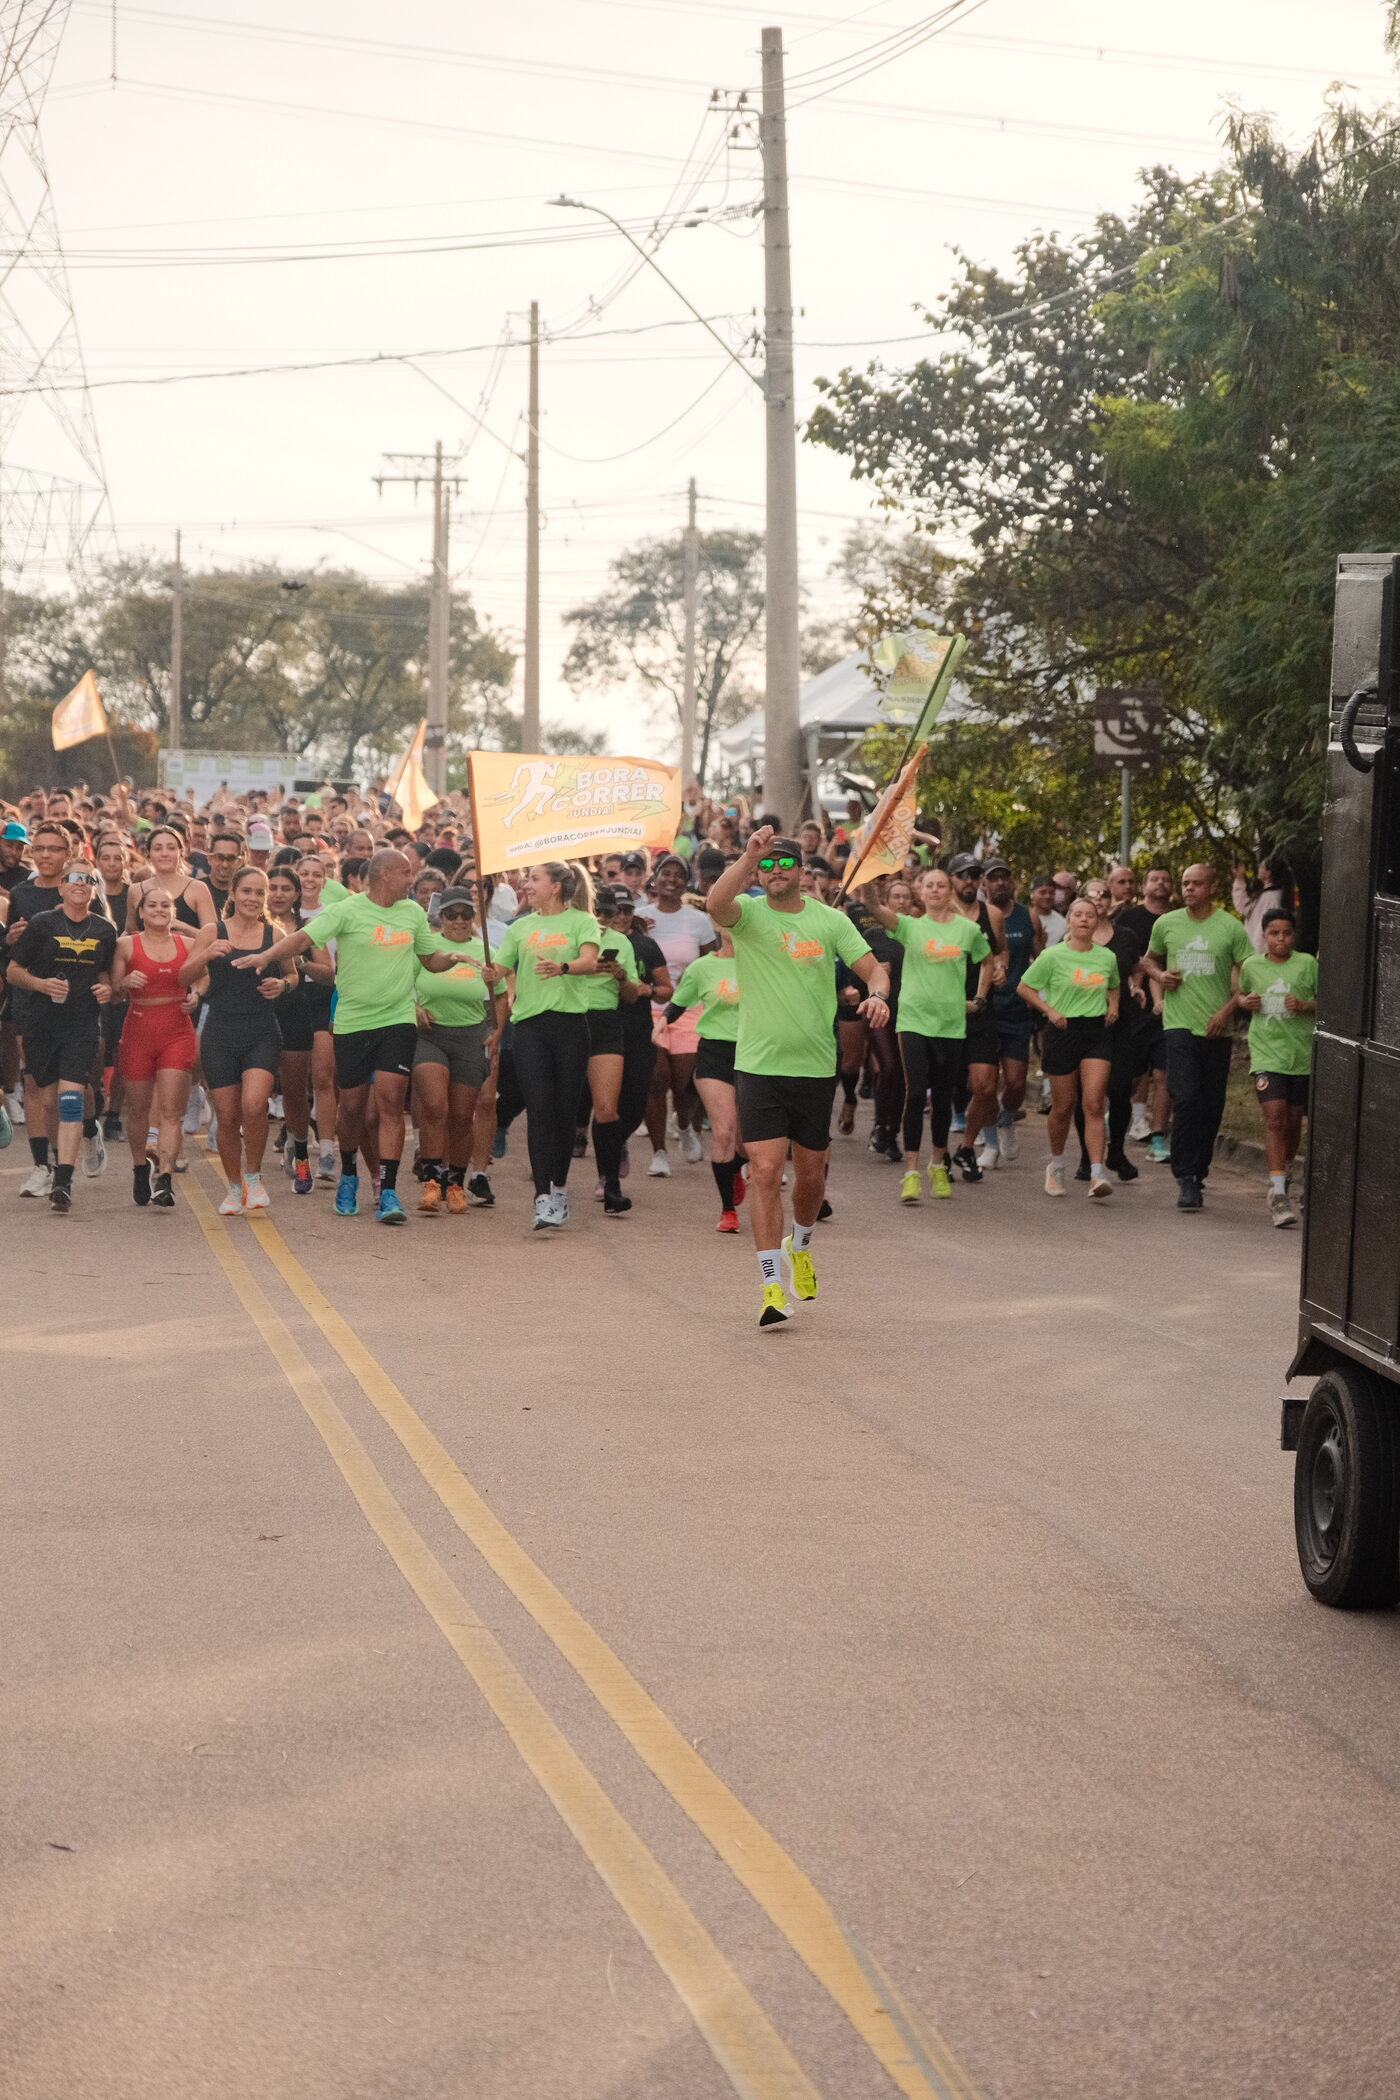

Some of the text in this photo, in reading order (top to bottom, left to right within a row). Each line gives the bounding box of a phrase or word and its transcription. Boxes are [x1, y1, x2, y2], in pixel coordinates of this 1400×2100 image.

[576, 767, 649, 791] BORA
[551, 783, 665, 812] CORRER
[761, 1258, 776, 1279] RUN
